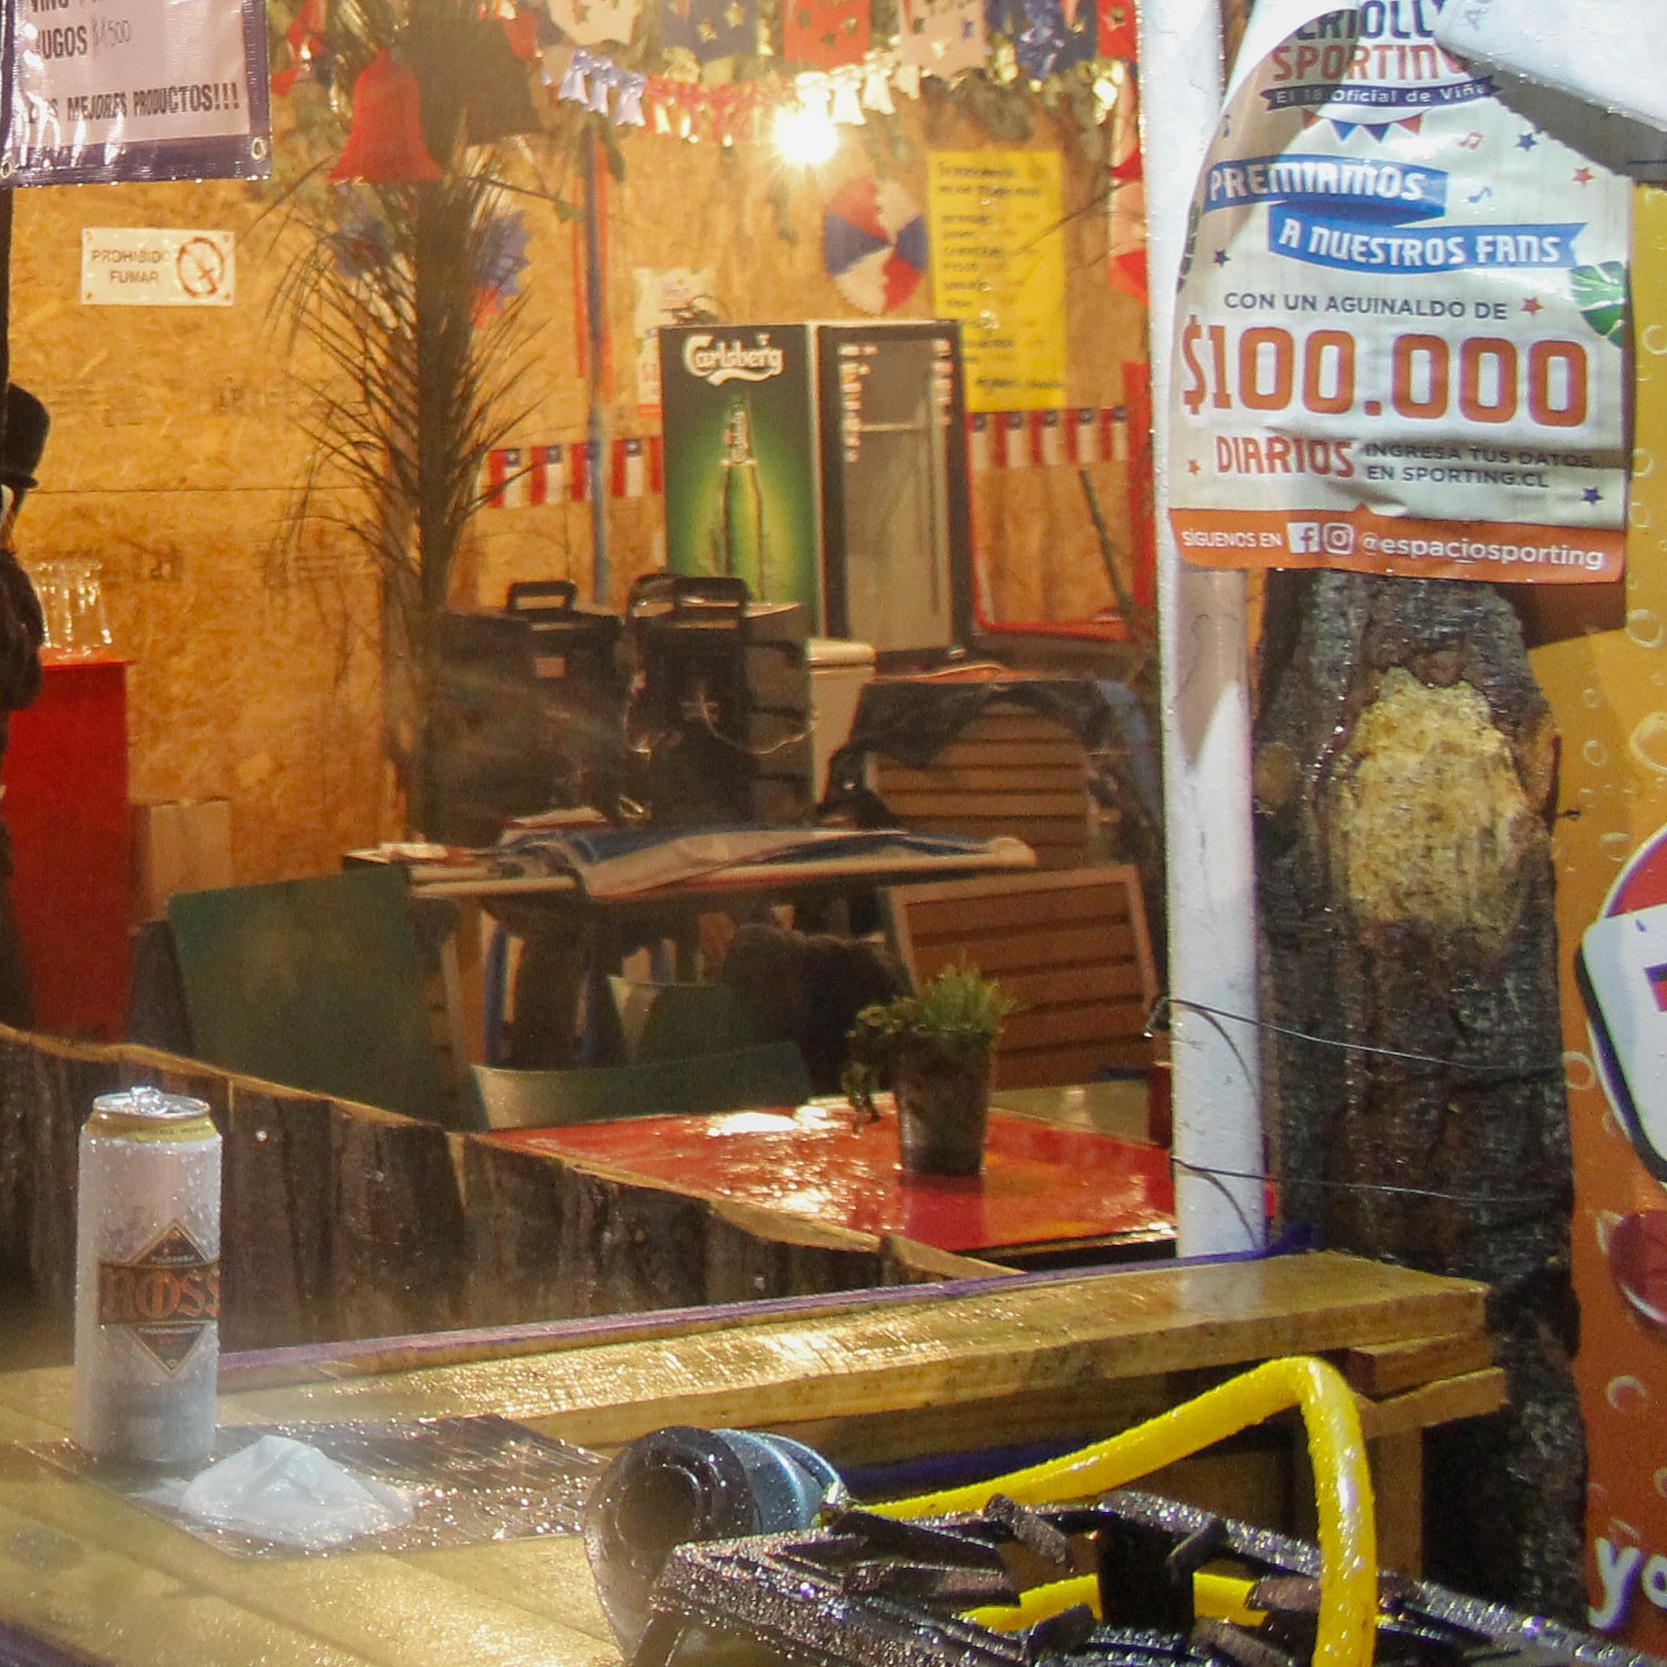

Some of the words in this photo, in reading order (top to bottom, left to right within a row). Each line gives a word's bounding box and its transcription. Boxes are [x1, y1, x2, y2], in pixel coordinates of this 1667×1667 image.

[133, 81, 240, 118] PRODUCTOS!!!
[1331, 88, 1397, 103] Oficial
[1405, 88, 1432, 103] de
[1210, 161, 1427, 202] PREMIAMOS
[1278, 218, 1300, 249] A
[1308, 228, 1465, 268] NUESTROS
[1474, 234, 1562, 264] FANS
[109, 270, 160, 284] FUMAR
[1224, 292, 1276, 311] CON
[1284, 294, 1318, 313] UN
[1327, 296, 1466, 318] AGUINALDO
[1474, 302, 1508, 320] DE
[682, 333, 785, 380] Carlsberg
[1181, 314, 1588, 428] $100.000
[1214, 435, 1355, 478] DIARIOS
[1366, 443, 1462, 462] INGRESA
[1468, 447, 1512, 465] TUS
[1366, 464, 1395, 481] EN
[1402, 465, 1549, 489] SPORTING.CL
[1260, 533, 1283, 548] EN
[1360, 530, 1605, 571] @espaciosporting
